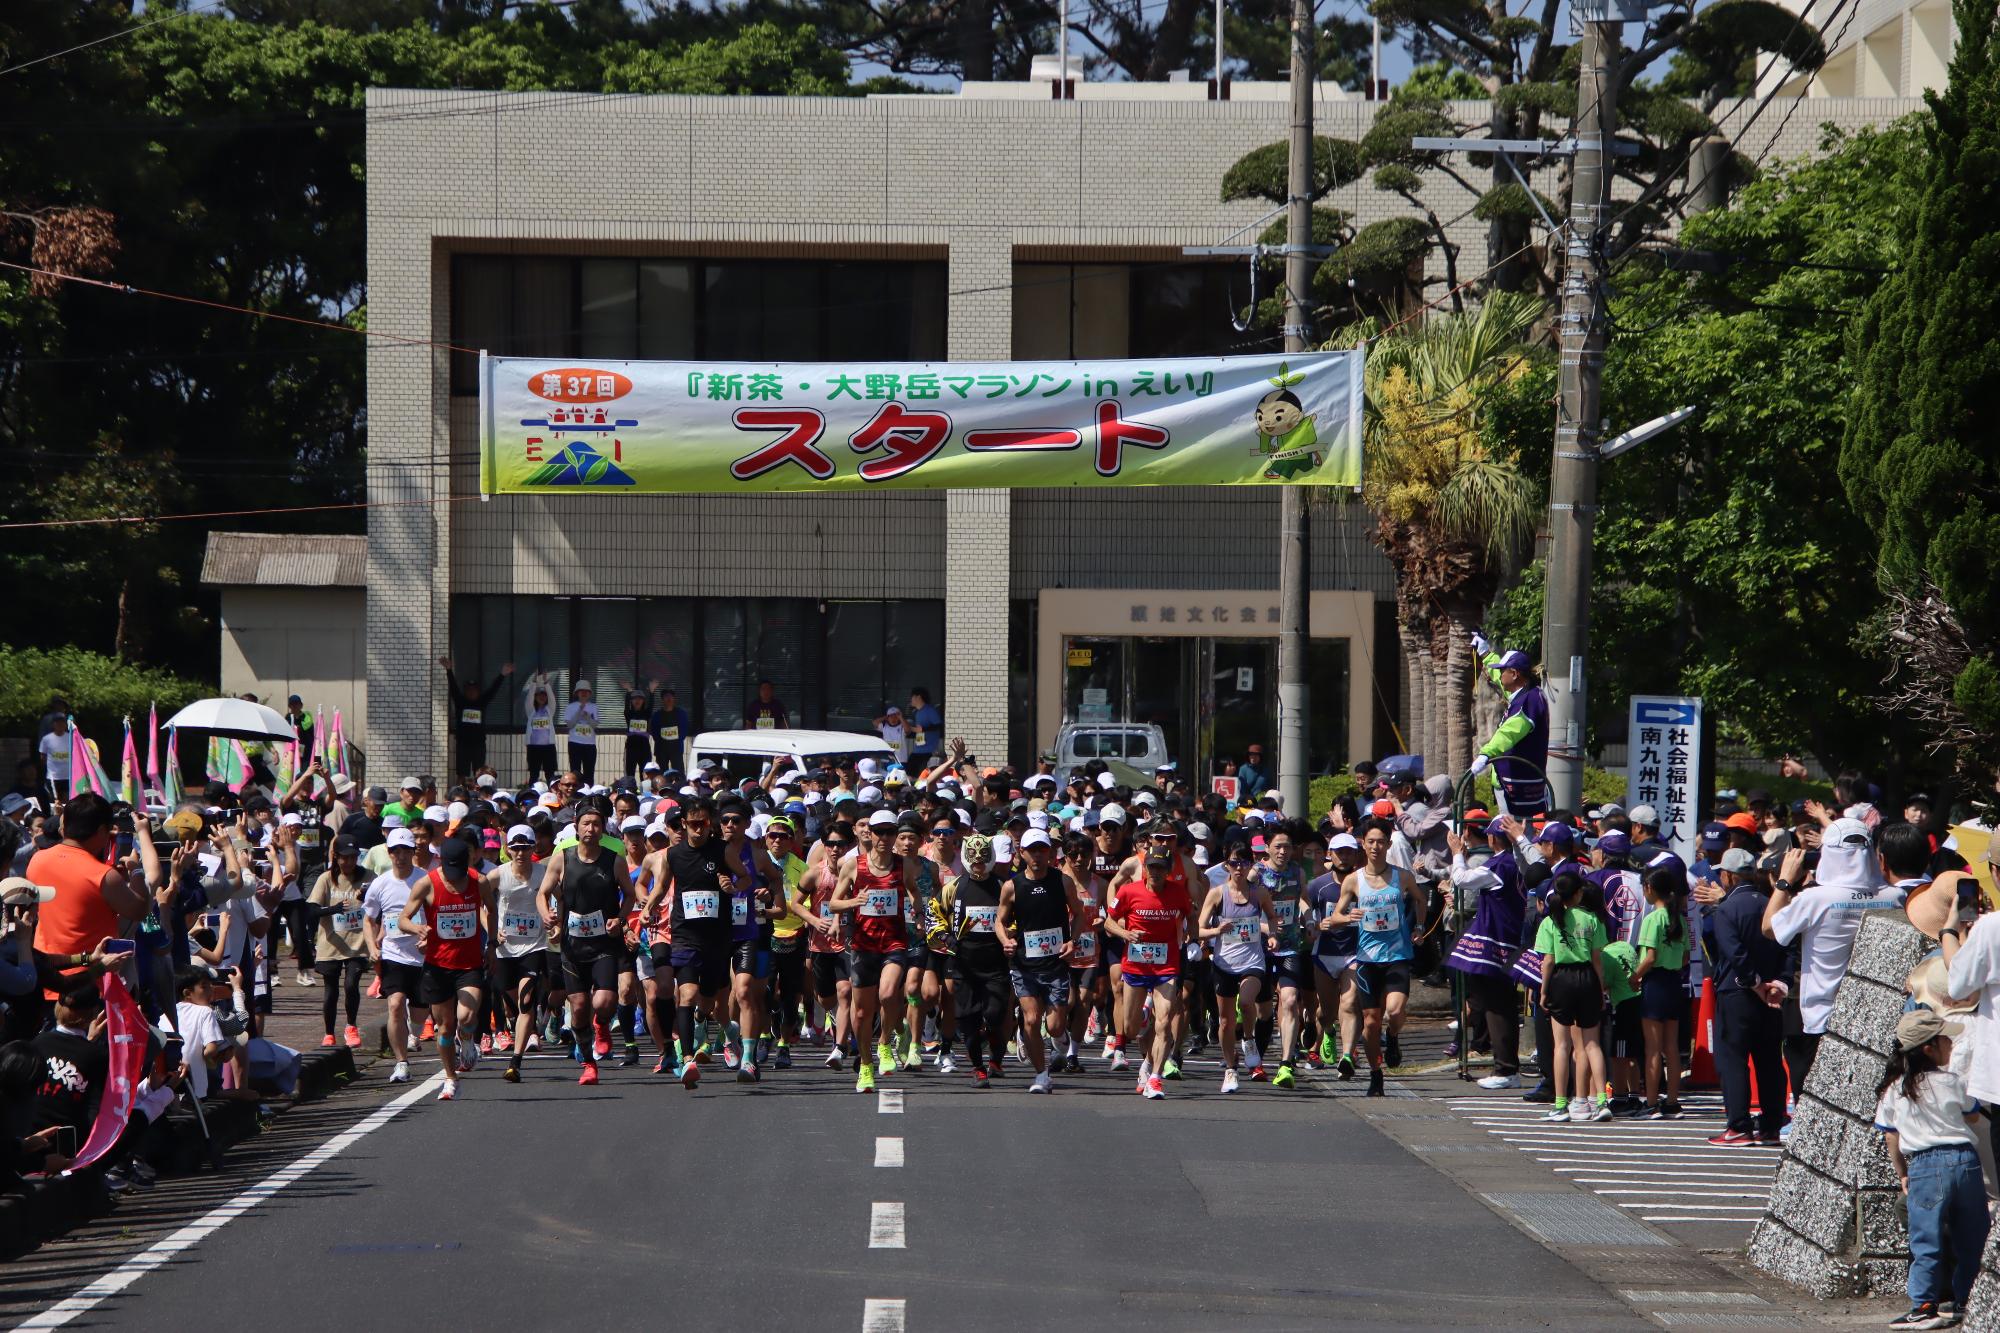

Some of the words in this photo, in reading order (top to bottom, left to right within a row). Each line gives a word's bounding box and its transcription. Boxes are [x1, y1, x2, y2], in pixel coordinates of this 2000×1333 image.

[542, 373, 615, 398] 第37回
[730, 399, 1170, 483] スタート
[1637, 726, 1663, 812] 南九州市
[1664, 727, 1690, 843] 社会福祉法人
[865, 896, 892, 909] -262
